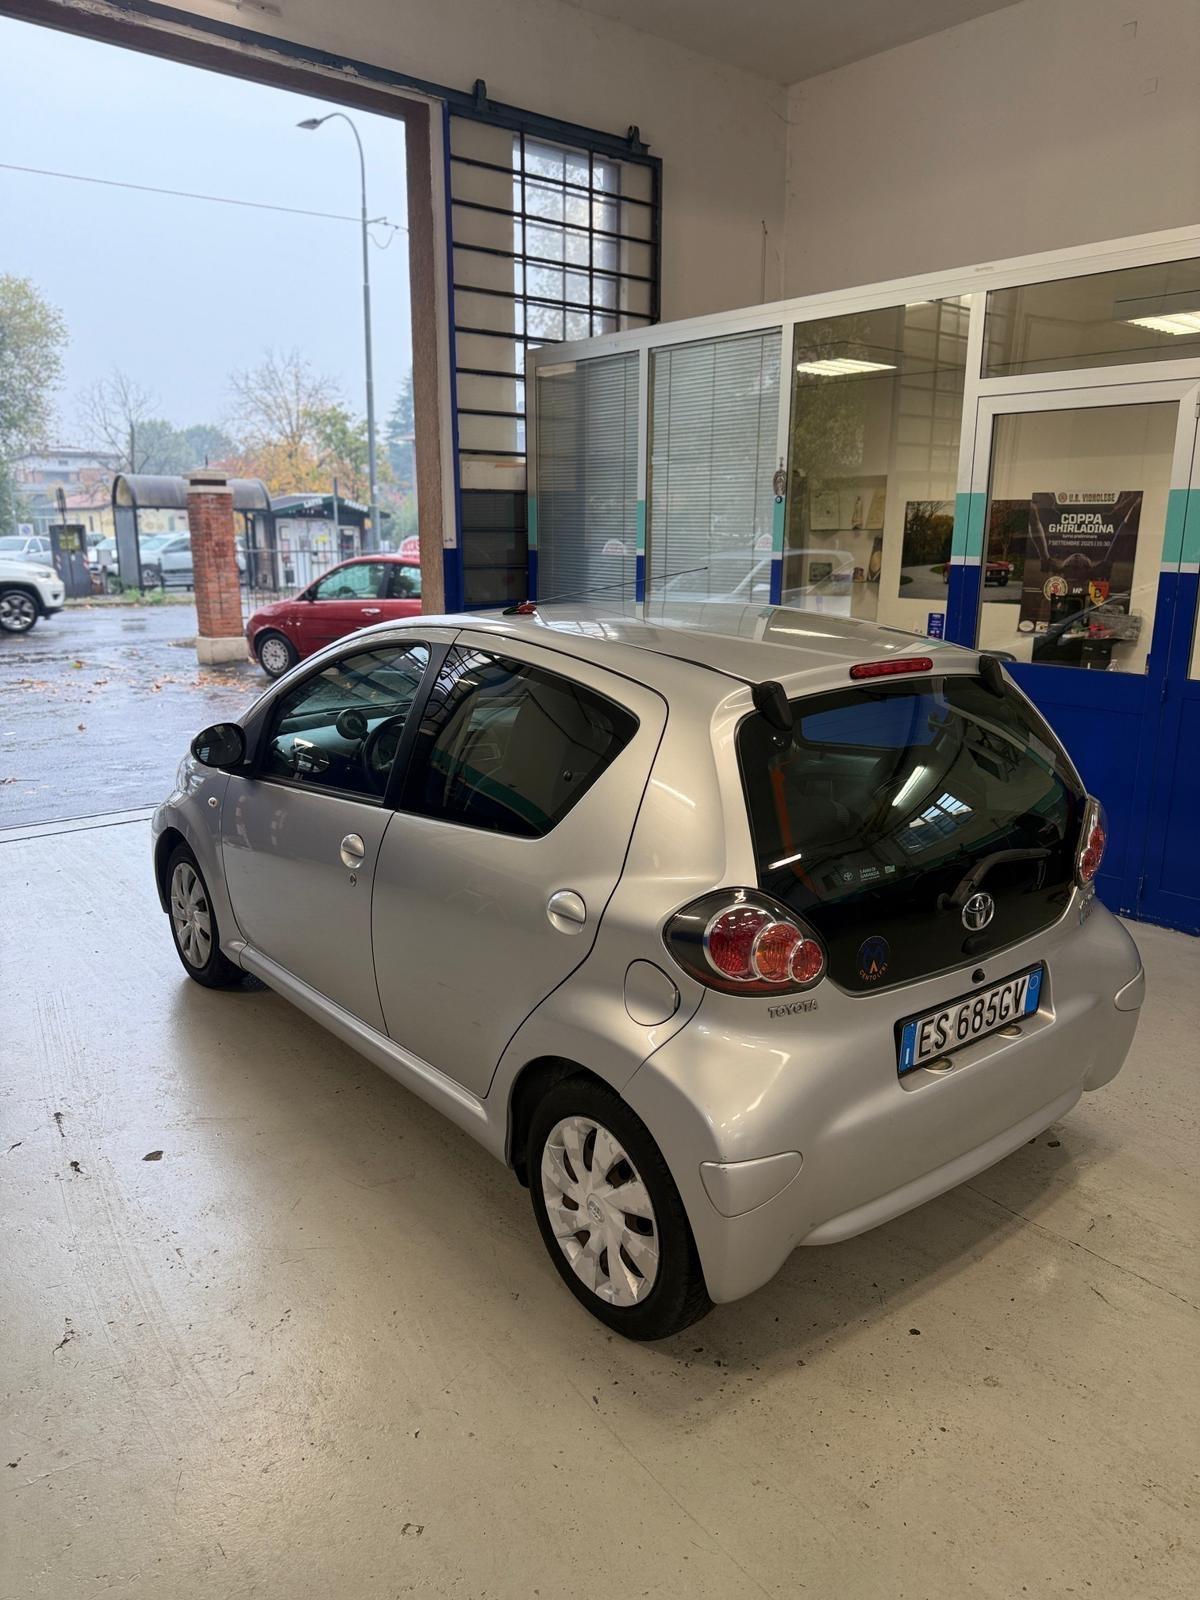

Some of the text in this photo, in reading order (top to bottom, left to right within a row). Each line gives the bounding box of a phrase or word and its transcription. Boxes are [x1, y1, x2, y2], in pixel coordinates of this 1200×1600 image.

[1061, 513, 1102, 524] COPPA
[1048, 524, 1114, 533] GHIRLADINA
[767, 999, 818, 1018] TOYOTA
[918, 978, 1026, 1058] ES 685GV
